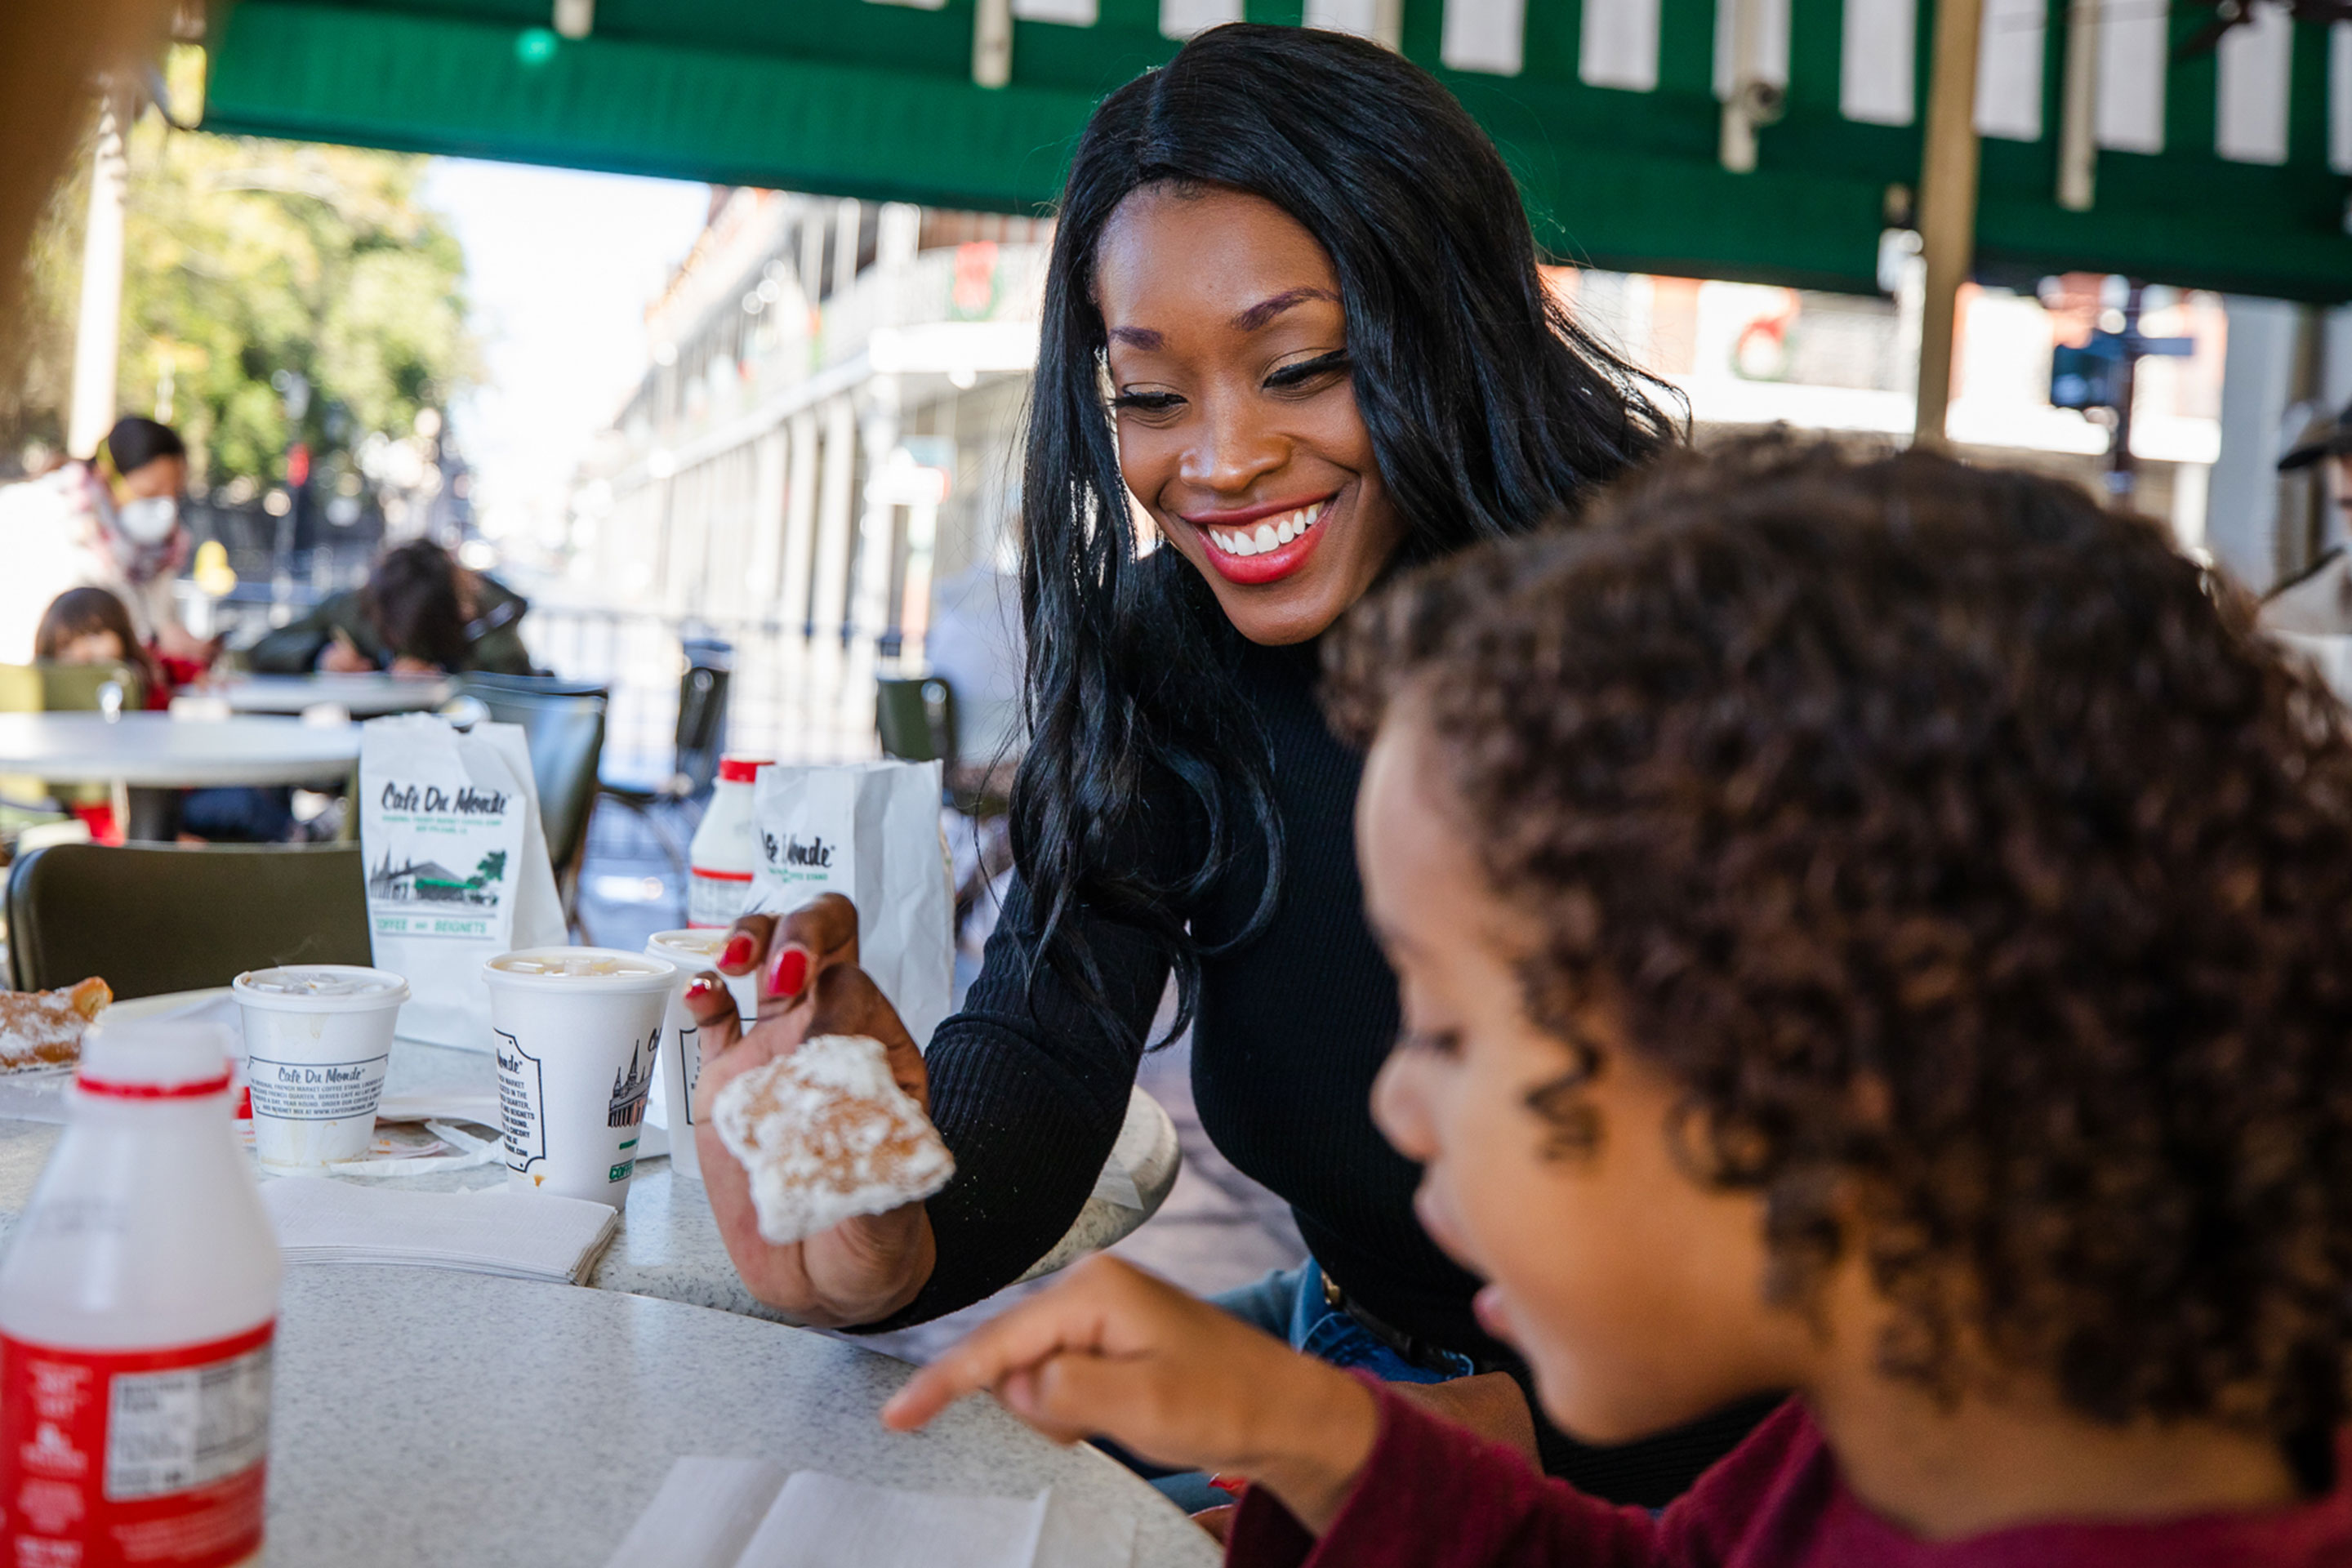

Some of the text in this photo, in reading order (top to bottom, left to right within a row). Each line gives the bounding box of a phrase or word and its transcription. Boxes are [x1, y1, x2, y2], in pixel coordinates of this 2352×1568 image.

[425, 786, 449, 812] Du
[452, 786, 506, 815] Monde
[305, 1068, 322, 1084] Du
[325, 1067, 361, 1084] Monde
[321, 1085, 342, 1093] COFFEE
